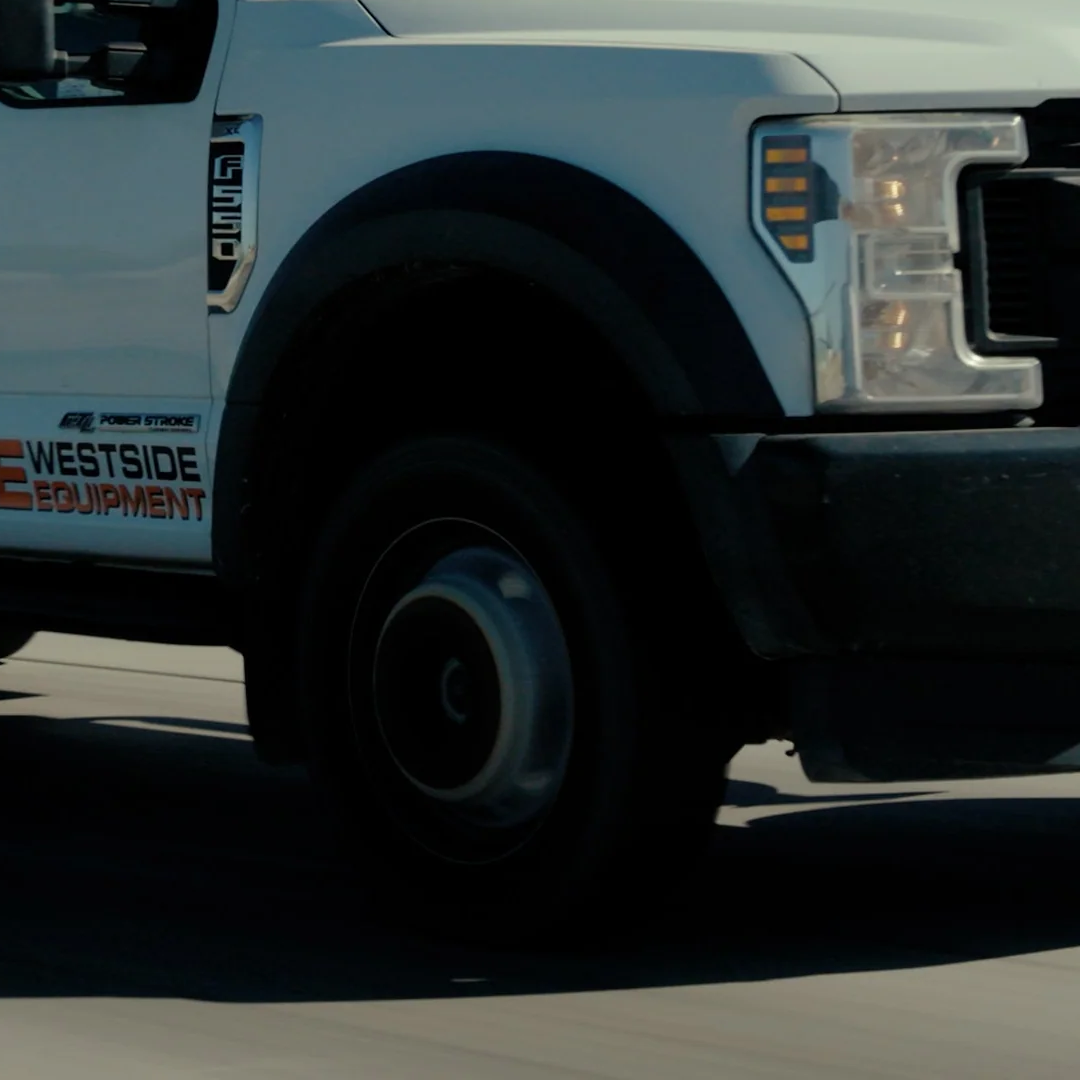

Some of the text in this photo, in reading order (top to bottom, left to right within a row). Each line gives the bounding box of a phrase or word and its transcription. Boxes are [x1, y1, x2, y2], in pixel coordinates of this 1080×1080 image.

[144, 415, 195, 427] STROKE
[26, 440, 202, 482] WESTSIDE
[32, 479, 206, 522] EQUIPMENT
